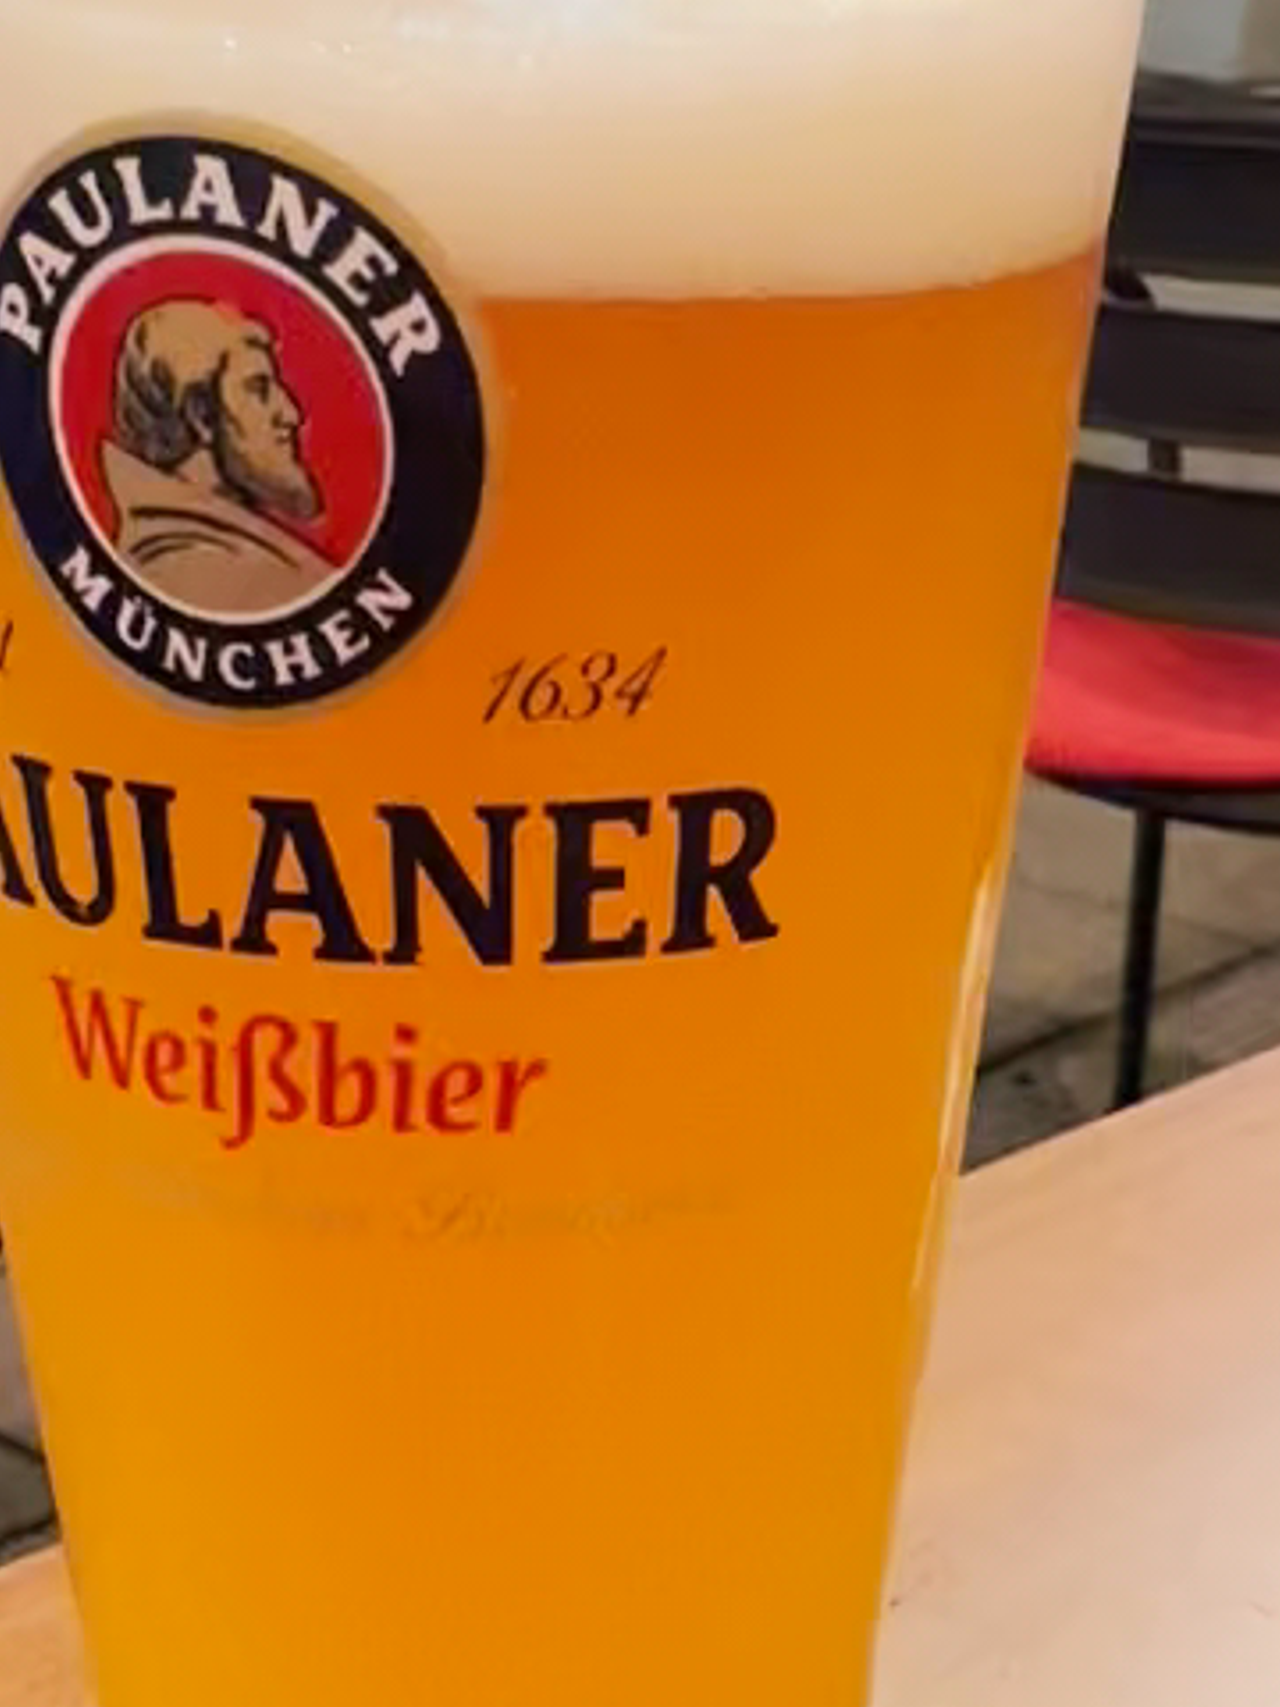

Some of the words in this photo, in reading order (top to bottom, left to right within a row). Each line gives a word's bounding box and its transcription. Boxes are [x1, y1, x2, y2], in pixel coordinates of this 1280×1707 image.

[60, 543, 415, 692] MÜNCHEN
[480, 645, 669, 726] 1634
[51, 974, 549, 1150] Weißbier
